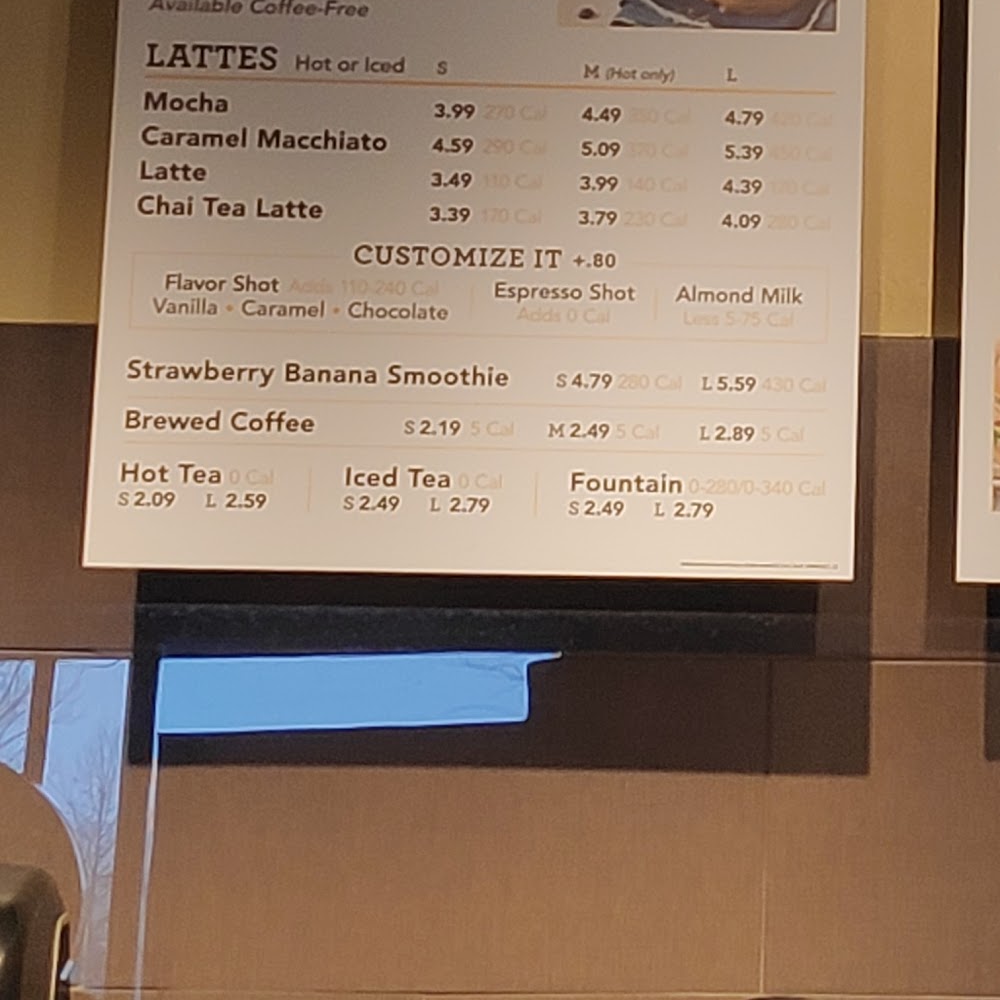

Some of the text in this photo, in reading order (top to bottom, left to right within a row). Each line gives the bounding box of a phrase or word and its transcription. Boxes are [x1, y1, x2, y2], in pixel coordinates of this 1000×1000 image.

[146, 42, 406, 74] LATTES Hot or Iced
[143, 91, 765, 127] Mocha 3.99 4.49 4.79
[141, 125, 764, 161] Caramel Macchiato 4.59 5.09 5.39
[139, 160, 763, 196] Latte 3.49 3.99 4.39
[137, 195, 762, 230] Chai Tea Latte 3.39 3.79 4.09
[354, 245, 617, 269] CUSTOMIZE IT +.80
[165, 273, 280, 294] Flavor Shot
[494, 281, 636, 304] Espresso Shot
[675, 285, 804, 305] Almond Milk
[153, 297, 449, 321] Vanilla Caramel Chocolate
[126, 359, 509, 388] Strawberry Banana Smoothie
[570, 373, 613, 390] 4.79
[716, 376, 757, 393] 5.59
[124, 409, 316, 434] Brewed Coffee
[419, 420, 462, 437] 2.19
[569, 423, 611, 440] 2.49
[714, 425, 755, 442] 2.89
[120, 462, 222, 486] Hot Tea
[344, 466, 451, 489] Iced Tea
[570, 471, 684, 495] Fountain
[133, 491, 267, 510] 2.09 2.59
[358, 496, 491, 514] 2.49 2.79
[583, 501, 715, 520] 2.49 2.79
